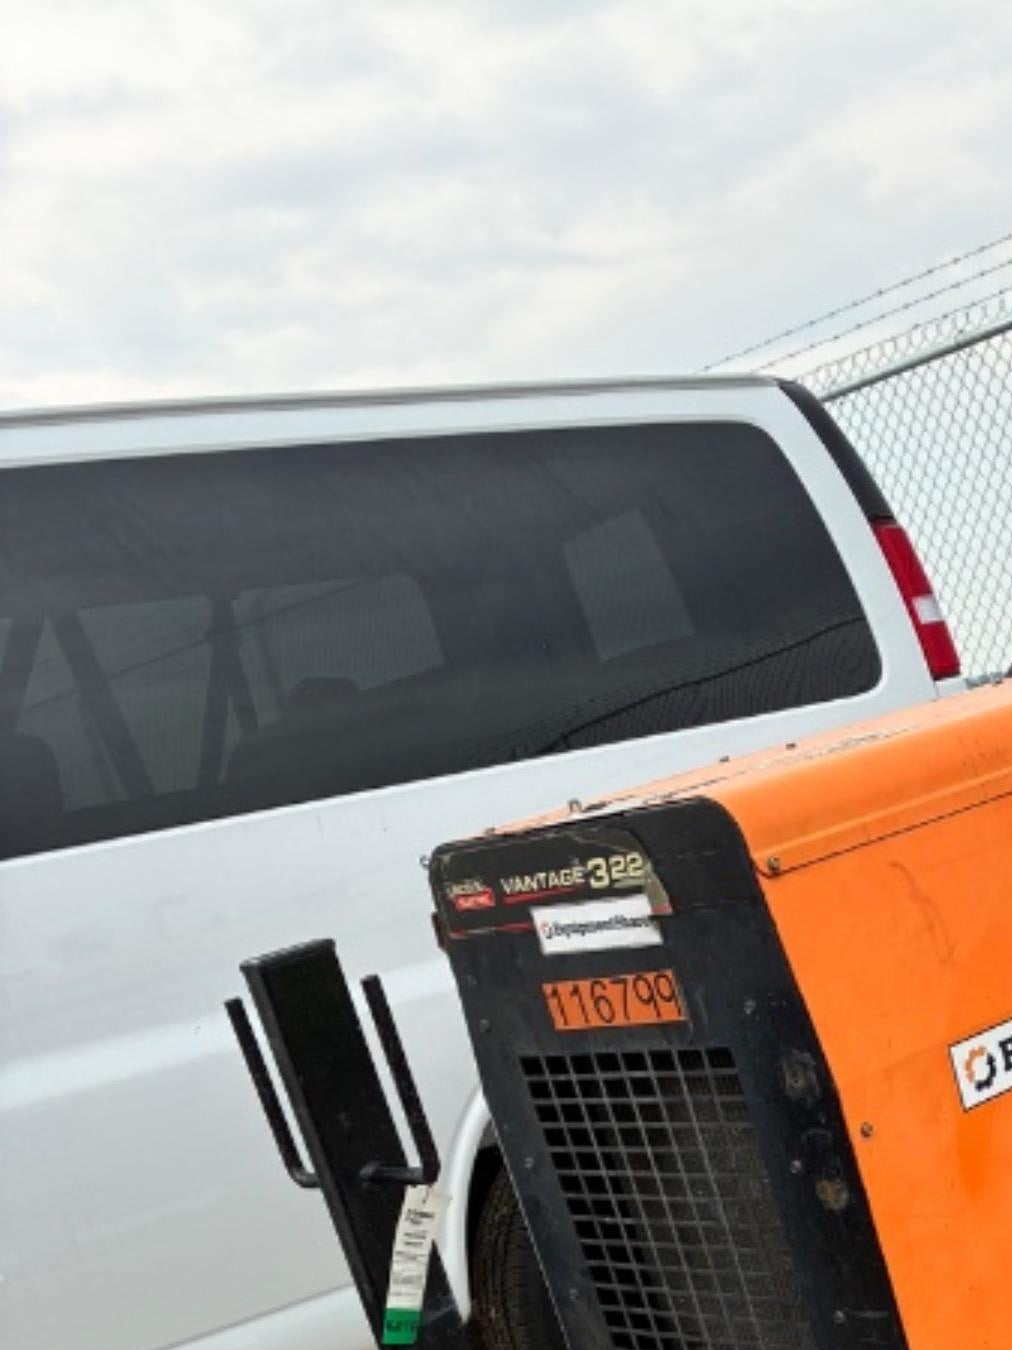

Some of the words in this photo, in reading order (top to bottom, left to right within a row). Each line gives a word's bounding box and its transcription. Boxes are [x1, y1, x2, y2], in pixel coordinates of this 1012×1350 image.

[500, 867, 588, 895] VANTAGE
[587, 852, 644, 889] 322
[550, 974, 684, 1025] 116799
